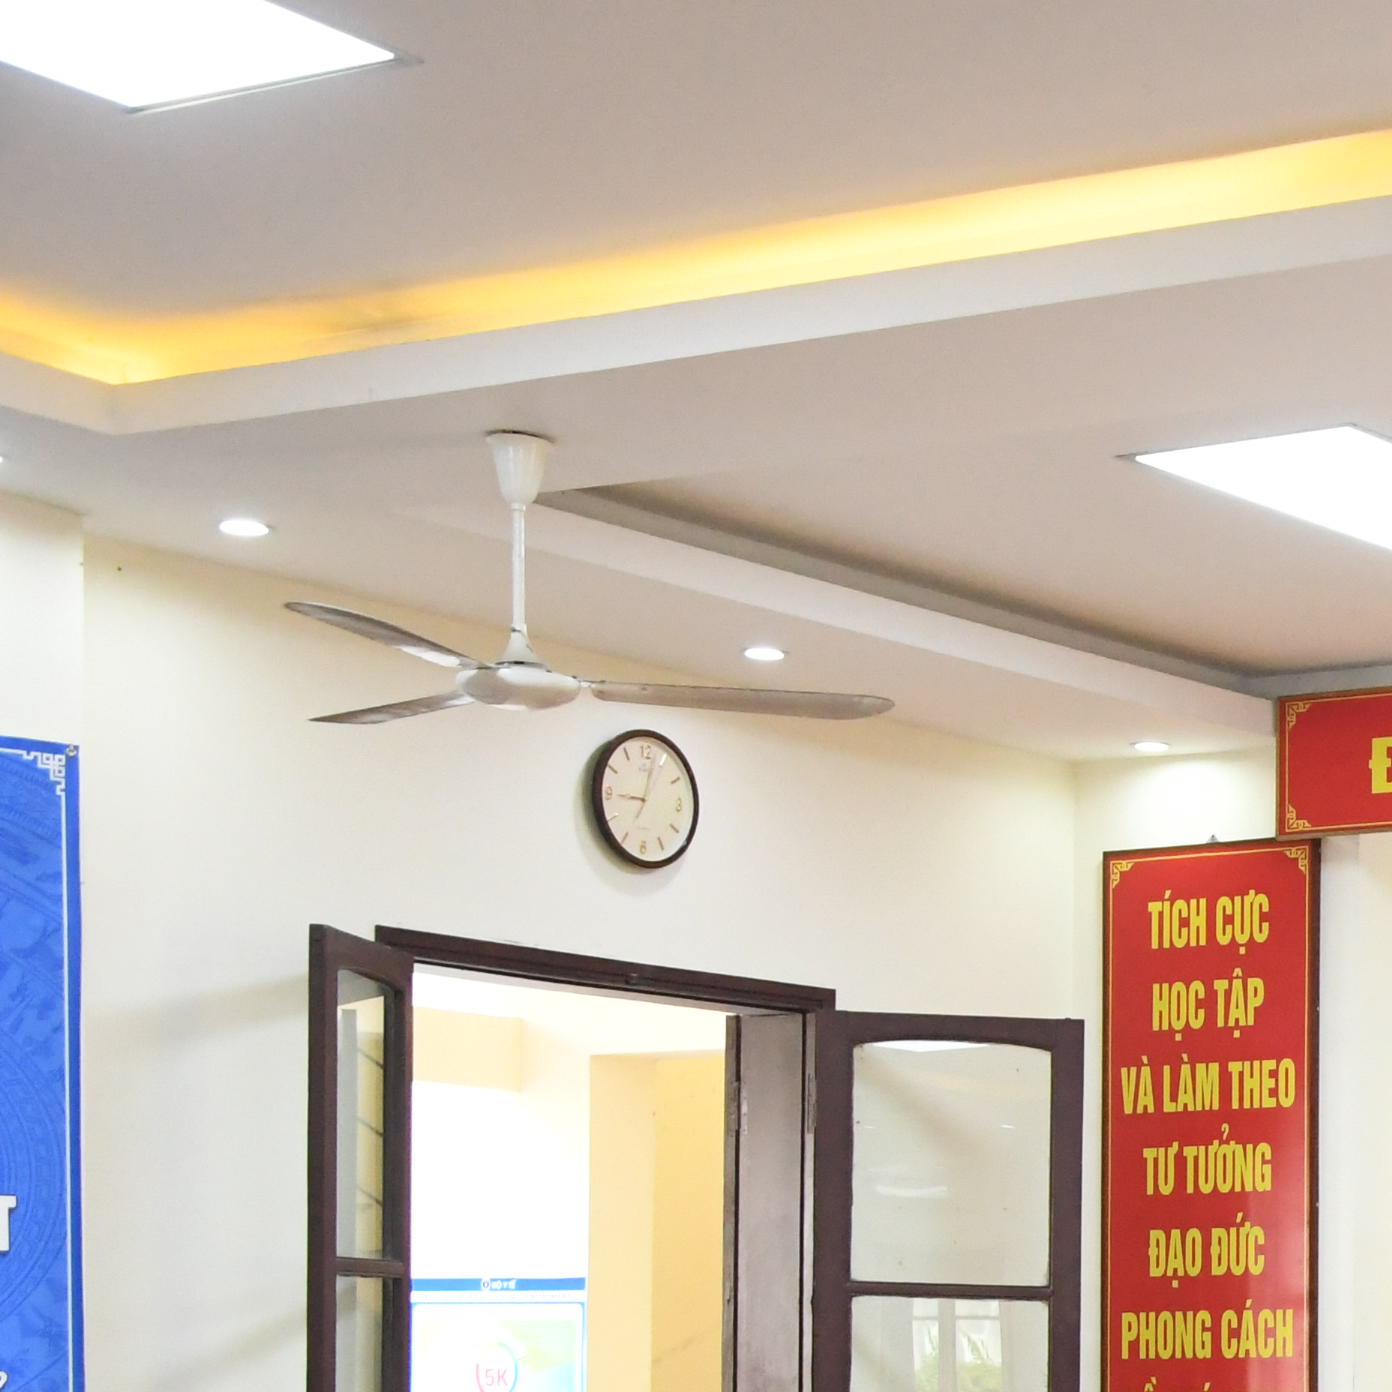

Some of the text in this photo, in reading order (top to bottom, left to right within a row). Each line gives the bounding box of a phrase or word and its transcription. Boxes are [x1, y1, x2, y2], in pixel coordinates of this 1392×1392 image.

[1148, 890, 1269, 954] TÍCH CỰC
[1153, 968, 1264, 1040] HỌC TẬP
[1121, 1054, 1295, 1114] VÀ LÀM THEO
[1143, 1124, 1272, 1195] TƯ TƯỞNG
[1149, 1212, 1265, 1287] ĐẠO ĐỨC
[1122, 1299, 1295, 1359] PHONG CÁCH
